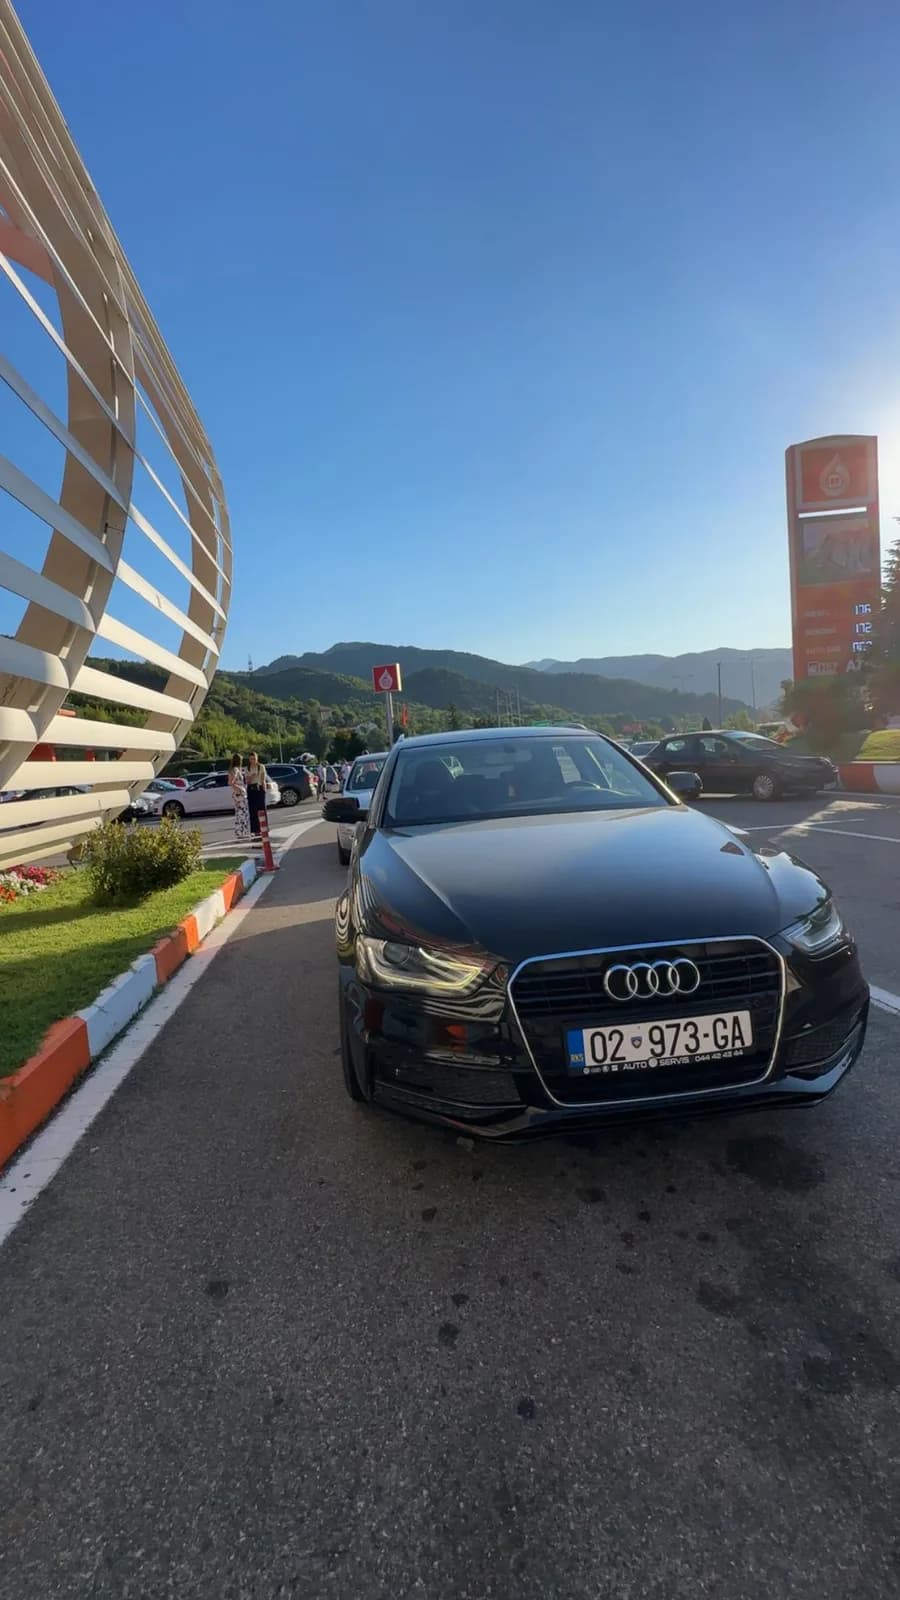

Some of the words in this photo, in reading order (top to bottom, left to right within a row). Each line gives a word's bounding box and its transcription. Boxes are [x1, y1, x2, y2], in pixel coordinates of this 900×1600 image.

[590, 1029, 626, 1064] 02
[649, 1015, 745, 1057] 973-GA
[623, 1061, 648, 1071] AUTO
[659, 1057, 690, 1067] SERVIS
